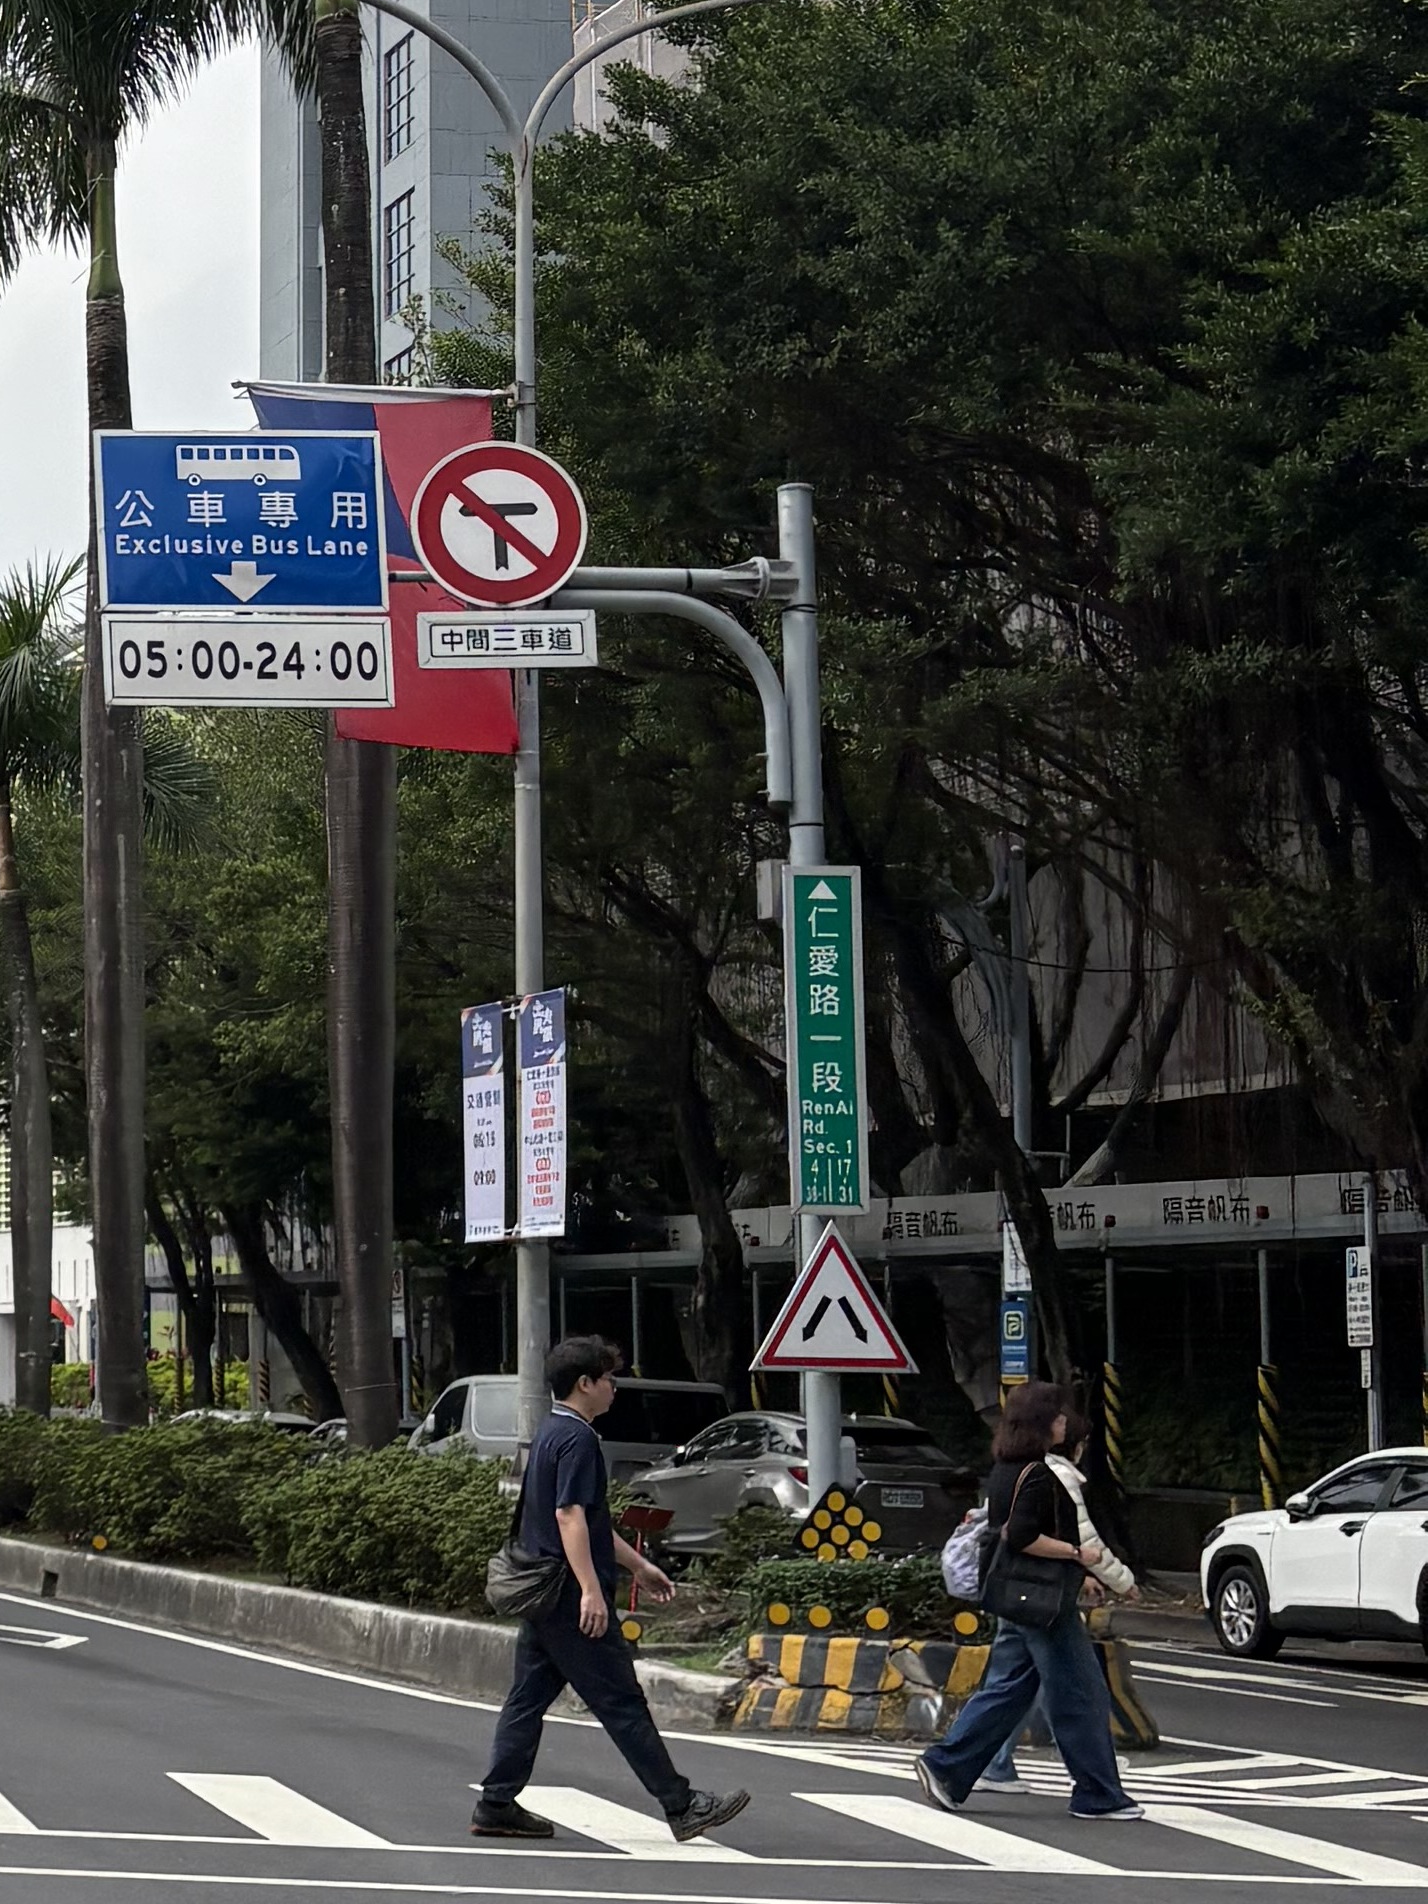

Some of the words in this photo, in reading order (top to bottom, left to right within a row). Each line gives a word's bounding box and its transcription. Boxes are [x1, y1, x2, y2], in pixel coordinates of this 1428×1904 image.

[115, 489, 368, 529] 公車專用
[115, 534, 244, 556] Exclusive
[251, 534, 299, 556] Bus
[307, 535, 369, 557] Lane
[441, 627, 573, 652] 中間三車道
[119, 639, 378, 681] 05:00-24:00
[807, 906, 843, 1094] 仁愛路一段
[803, 1119, 829, 1134] Rd.
[804, 1139, 840, 1154] Sec.
[846, 1139, 852, 1154] 1
[1162, 1195, 1251, 1225] 隔音帆布
